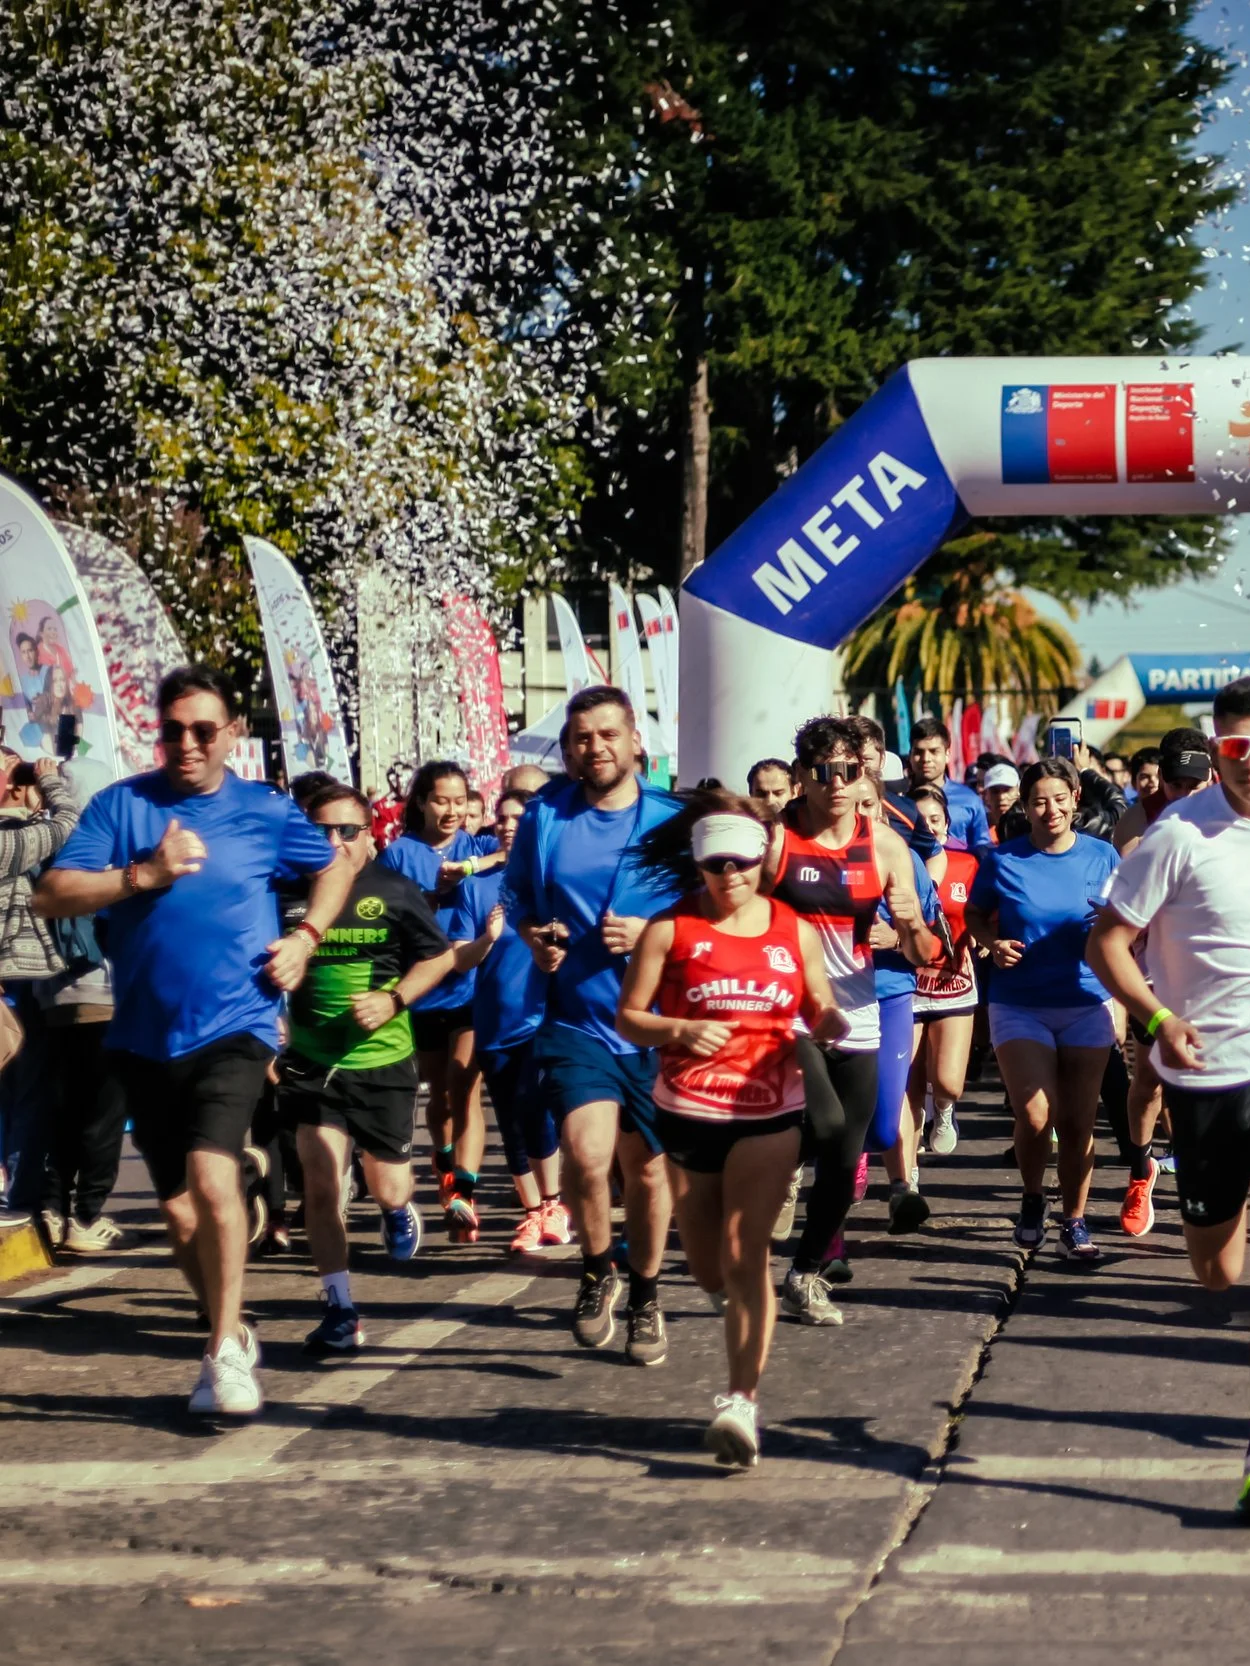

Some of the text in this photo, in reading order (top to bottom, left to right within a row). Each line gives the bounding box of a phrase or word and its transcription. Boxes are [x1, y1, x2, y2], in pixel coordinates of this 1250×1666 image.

[752, 451, 928, 617] META
[323, 928, 388, 944] NNERS
[686, 979, 795, 1008] CHILLÁN
[706, 999, 774, 1013] RUNNERS
